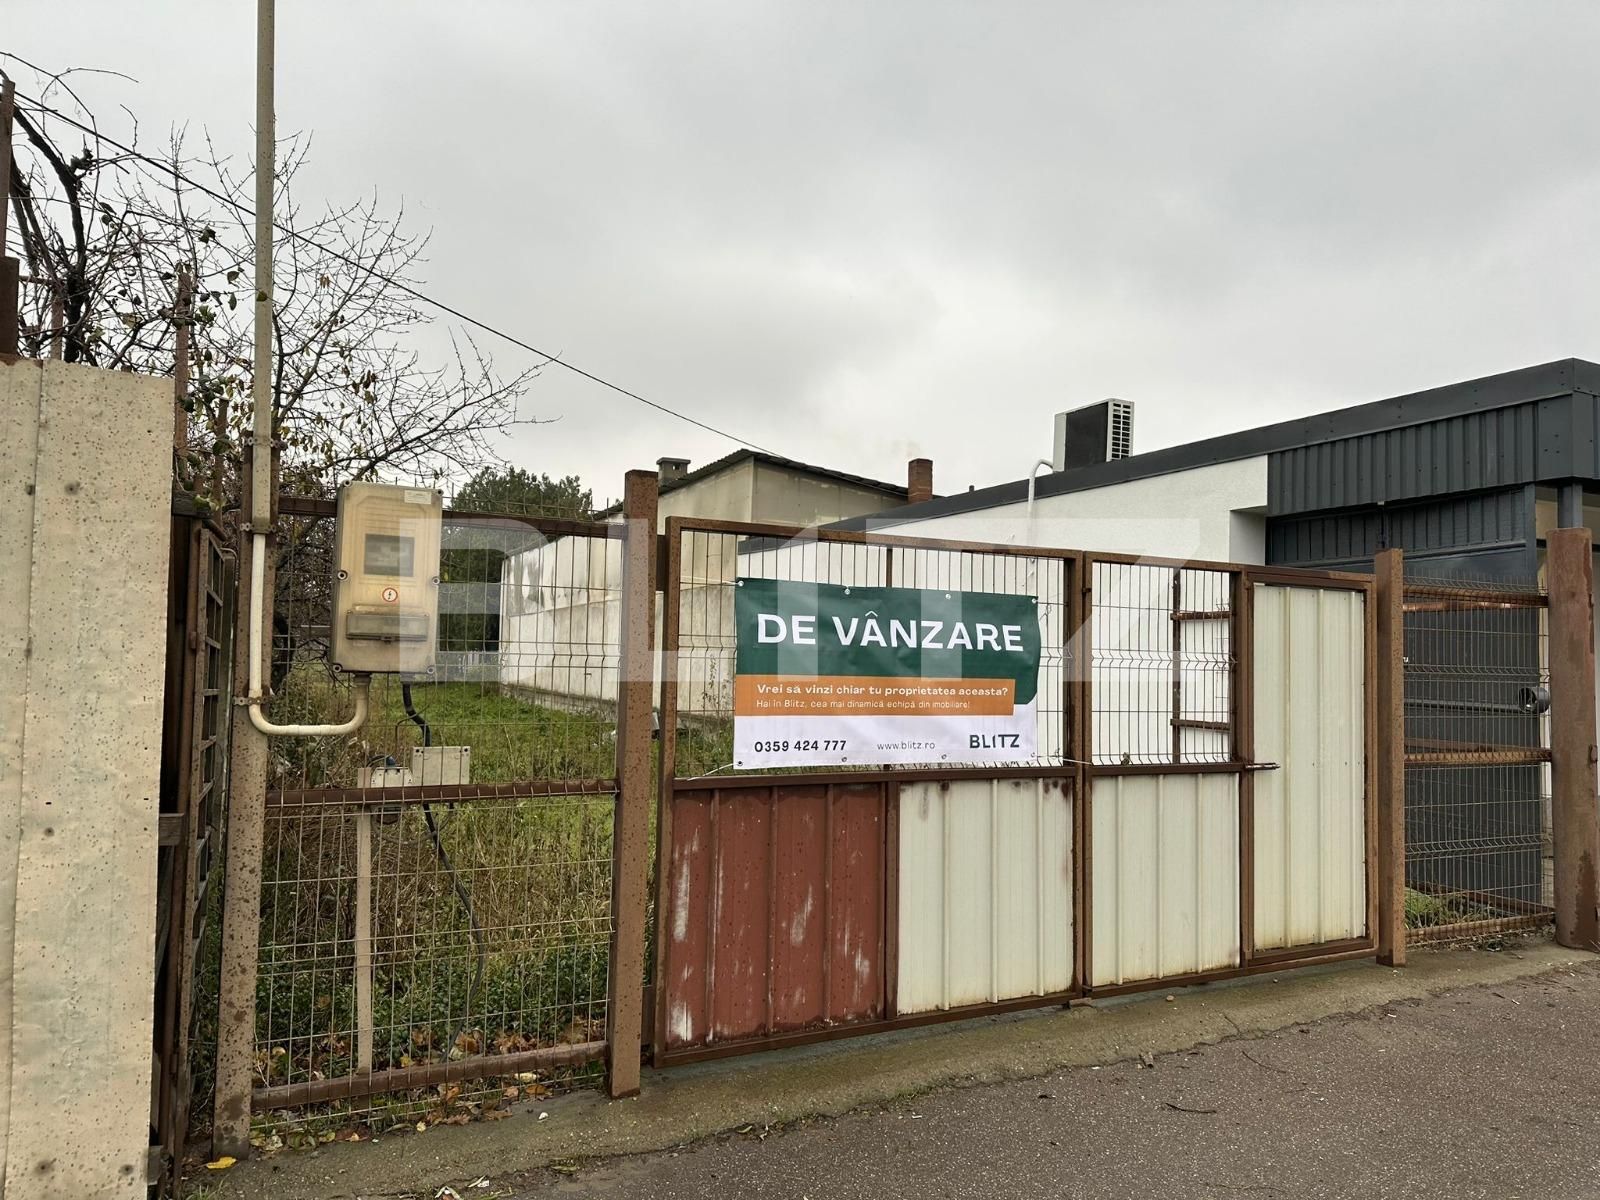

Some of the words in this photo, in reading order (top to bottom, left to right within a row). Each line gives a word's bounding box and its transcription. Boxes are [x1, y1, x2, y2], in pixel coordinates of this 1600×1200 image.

[757, 613, 816, 645] DE
[832, 610, 1024, 651] VÂNZARE
[757, 684, 783, 694] Vrei
[786, 684, 801, 694] să
[805, 684, 833, 694] vinzi
[836, 684, 865, 695] chiar
[869, 686, 882, 695] tu
[884, 686, 956, 697] proprietatea
[958, 687, 1008, 696] aceasta?
[756, 699, 771, 708] Hai
[830, 700, 845, 708] mai
[847, 699, 884, 708] dinamică
[887, 700, 915, 709] echipă
[918, 700, 931, 708] din
[754, 740, 789, 752] 0359
[793, 740, 819, 751] 424
[823, 740, 847, 751] 777
[877, 740, 936, 750] www.blitz.ro
[969, 734, 1020, 749] BLITZ
